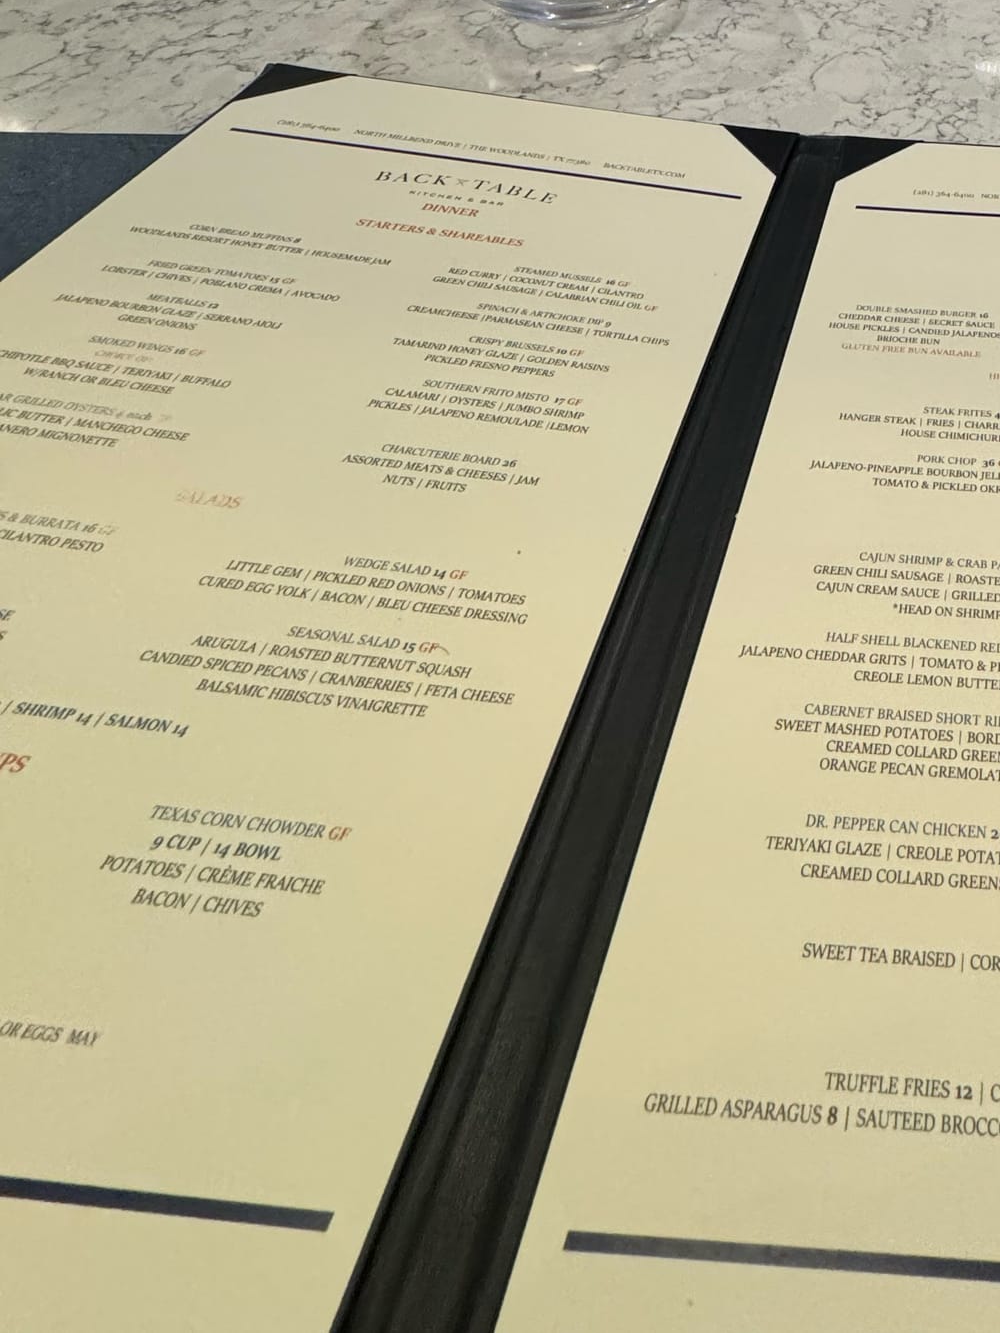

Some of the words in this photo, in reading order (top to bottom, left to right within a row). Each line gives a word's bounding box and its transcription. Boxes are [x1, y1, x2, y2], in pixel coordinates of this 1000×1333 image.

[374, 170, 451, 186] BACK
[473, 179, 557, 204] TABLE
[420, 202, 479, 217] DINNER
[355, 218, 426, 234] STARTERS
[425, 227, 437, 236] &
[438, 228, 524, 247] SHAREABLES
[467, 335, 505, 346] CRISPY
[503, 339, 556, 353] BRUSSELS
[554, 347, 568, 355] 10
[568, 348, 584, 357] GF
[421, 379, 482, 393] SOUTHERN
[481, 386, 515, 398] FRITO
[514, 390, 550, 402] MISTO
[553, 396, 566, 406] 17
[566, 397, 583, 406] GF
[341, 454, 403, 469] ASSORTED
[402, 460, 444, 474] MEATS
[443, 466, 454, 476] &
[455, 467, 508, 482] CHEESES
[513, 474, 540, 486] JAM
[380, 443, 461, 461] CHARCUTERIE
[461, 453, 501, 466] BOARD
[500, 459, 518, 468] 26
[381, 473, 416, 486] NUTS
[423, 479, 467, 493] FRUITS
[343, 555, 390, 571] WEDGE
[389, 561, 432, 576] SALAD
[431, 568, 447, 580] 14
[448, 569, 468, 580] GF
[858, 551, 896, 564] CAJUN
[898, 553, 943, 566] SHRIMP
[945, 557, 954, 567] &
[956, 557, 988, 569] CRAB
[286, 625, 355, 645] SEASONAL
[356, 634, 401, 649] SALAD
[401, 641, 417, 654] 15
[417, 641, 436, 654] GF
[189, 635, 257, 653] ARUGULA
[267, 643, 332, 662] ROASTED
[331, 651, 417, 673] BUTTERNUT
[415, 661, 473, 679] SQUASH
[194, 678, 269, 698] BALSAMIC
[266, 686, 335, 706] HIBISCUS
[336, 695, 429, 717] VINAIGRETTE
[11, 701, 77, 720] SHRIMP
[74, 712, 93, 726] 14
[103, 713, 173, 733] SALMON
[171, 724, 190, 738] 14
[149, 804, 201, 824] TEXAS
[199, 810, 247, 829] CORN
[245, 816, 326, 839] CHOWDER
[327, 826, 352, 841] GF
[804, 813, 828, 829] DR.
[832, 815, 885, 833] PEPPER
[889, 819, 919, 834] CAN
[922, 821, 987, 839] CHICKEN
[148, 836, 164, 851] 9
[165, 833, 202, 851] CUP
[212, 843, 232, 859] 14
[232, 841, 281, 862] BOWL
[98, 854, 187, 879] POTATOES
[196, 864, 256, 887] CRÈME
[253, 872, 326, 895] FRAICHE
[130, 887, 192, 909] BACON
[201, 896, 264, 918] CHIVES
[824, 1072, 899, 1095] TRUFFLE
[902, 1077, 951, 1100] FRIES
[955, 1084, 973, 1101] 12
